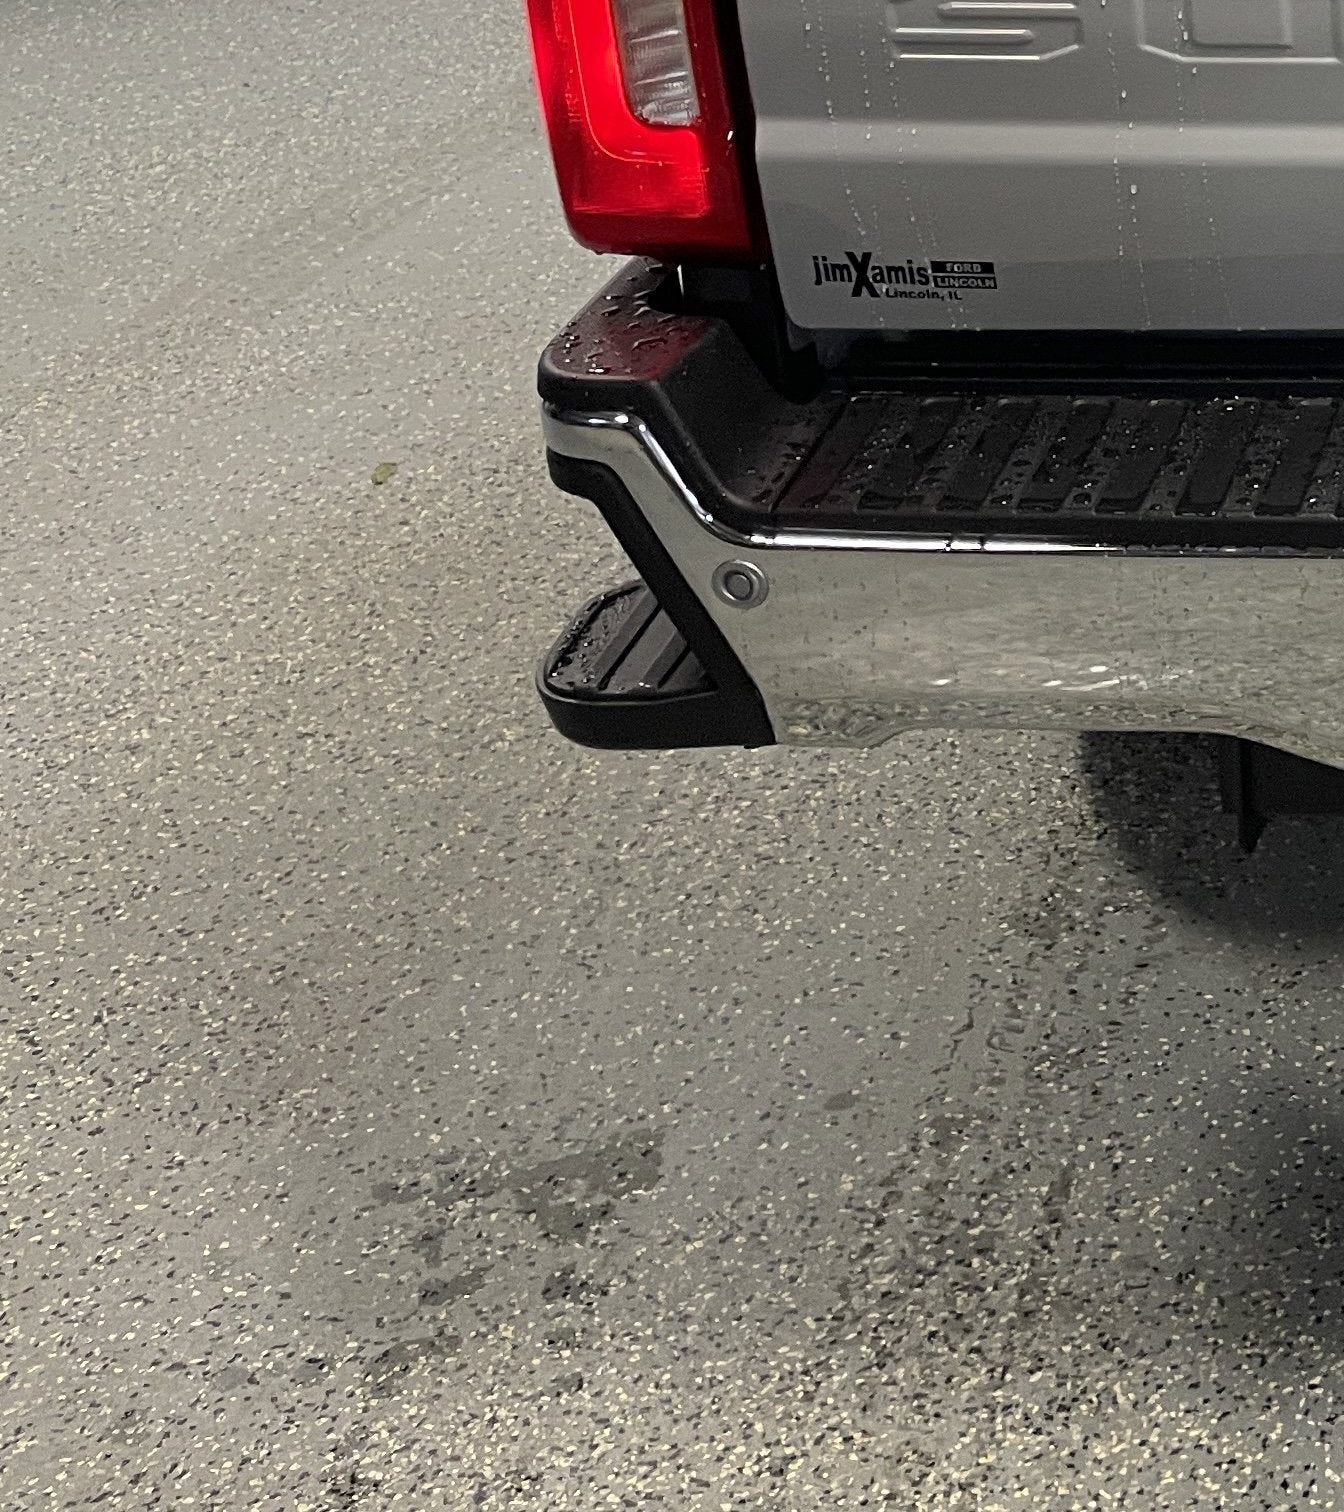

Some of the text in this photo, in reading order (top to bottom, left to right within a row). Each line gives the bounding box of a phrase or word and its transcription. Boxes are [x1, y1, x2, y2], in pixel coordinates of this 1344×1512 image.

[946, 262, 981, 273] FORD
[937, 277, 995, 288] LINCOLN
[885, 287, 944, 301] Lincoln,
